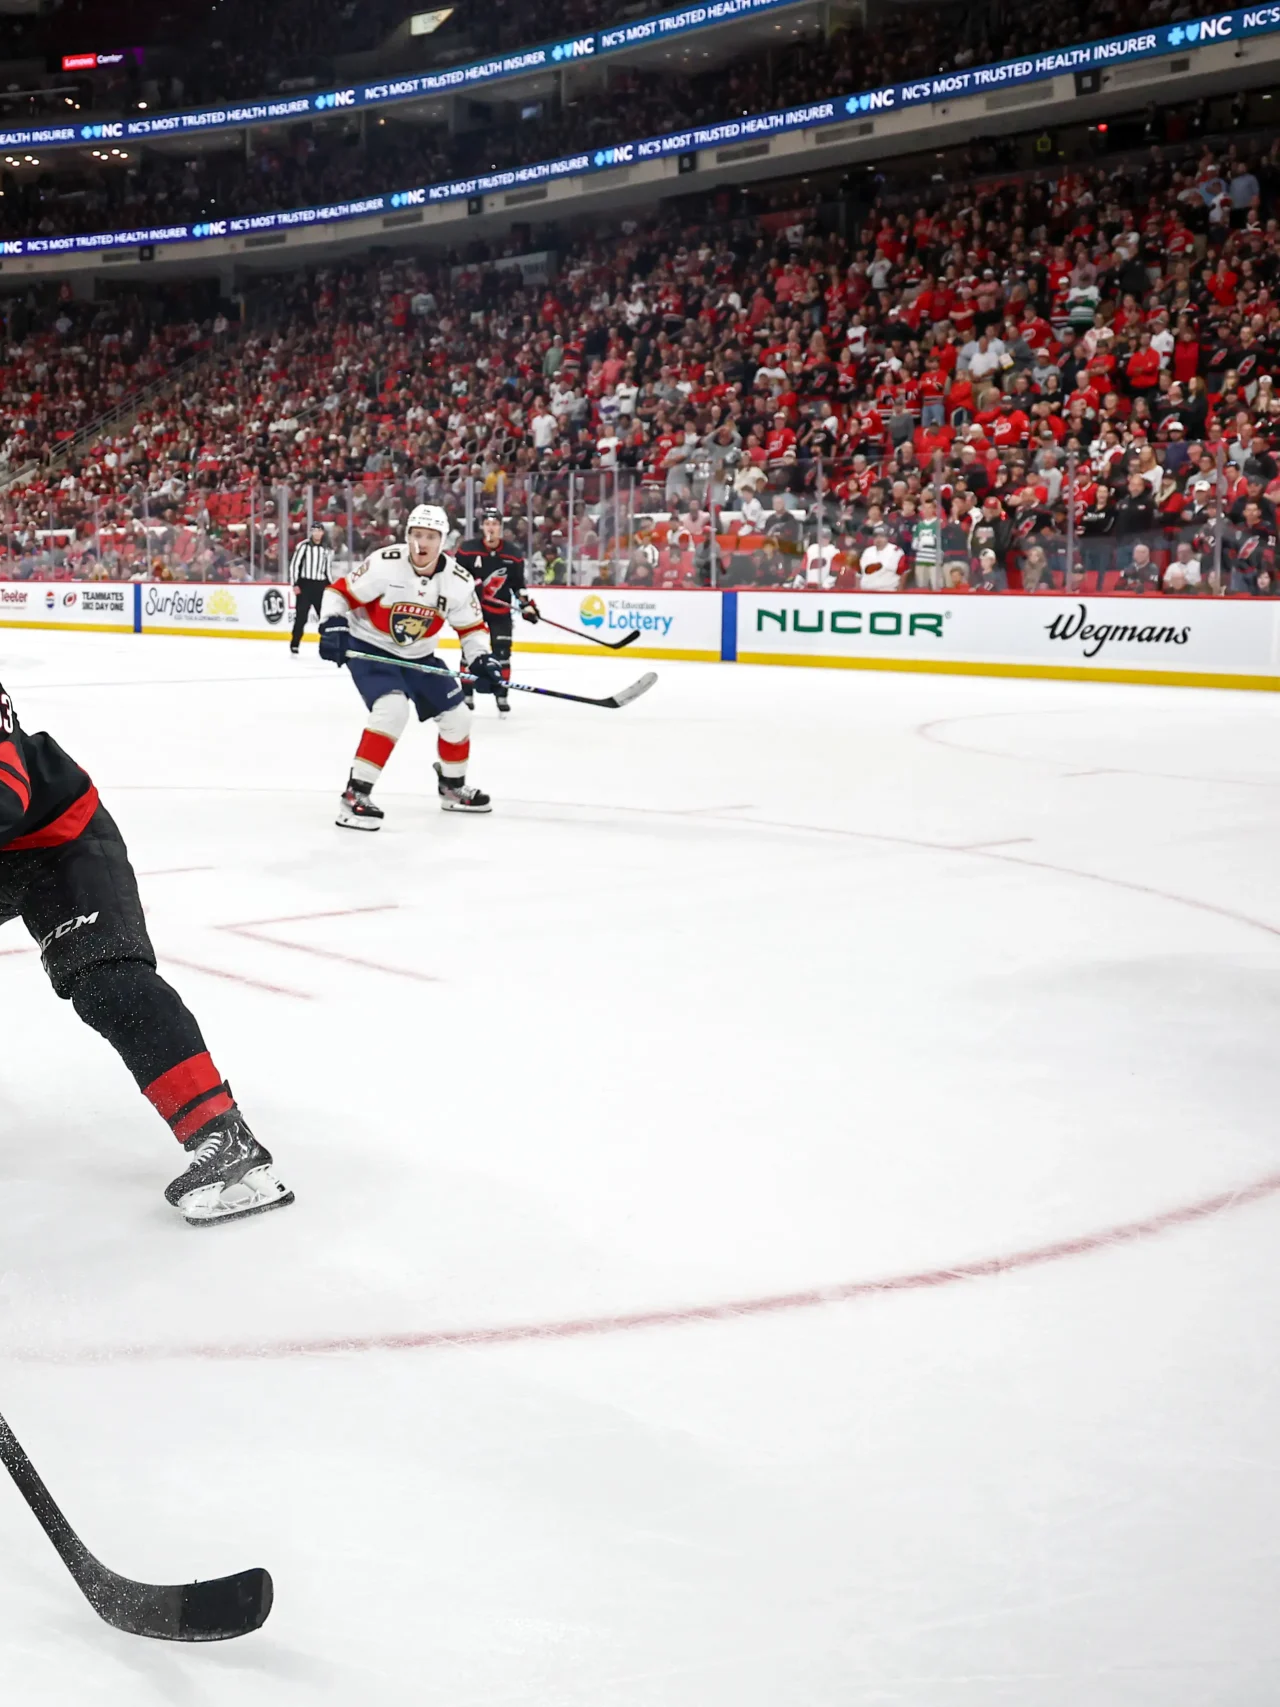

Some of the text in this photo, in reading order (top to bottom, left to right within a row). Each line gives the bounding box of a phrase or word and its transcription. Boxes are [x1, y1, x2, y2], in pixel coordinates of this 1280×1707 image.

[1243, 7, 1280, 27] NC'S
[601, 31, 626, 46] NC'S
[626, 22, 657, 39] MOST
[658, 9, 707, 31] TRUSTED
[1199, 16, 1233, 39] NC
[572, 38, 596, 56] NC
[364, 51, 546, 99] NC'S MOST TRUSTED HEALTH INSURER
[901, 35, 1157, 100] NC'S MOST TRUSTED HEALTH INSURER
[334, 90, 356, 107] NC
[869, 89, 895, 109] NC
[127, 100, 310, 133] NC'S MOST TRUSTED HEALTH INSURER
[31, 129, 75, 141] INSURER
[102, 123, 124, 137] NC
[638, 104, 834, 156] NC'S MOST TRUSTED HEALTH INSURER
[608, 145, 634, 162] NC
[429, 156, 589, 198] NC'S MOST TRUSTED HEALTH INSURER
[406, 190, 426, 204] NC
[230, 198, 384, 230] NC'S MOST TRUSTED HEALTH INSURER
[27, 227, 188, 250] NC'S MOST TRUSTED HEALTH INSURER
[208, 222, 227, 235] NC
[3, 241, 23, 253] NC
[0, 588, 28, 603] Teeter
[81, 591, 124, 601] TEAMMATES
[145, 587, 204, 616] Surfside
[436, 595, 448, 612] A
[95, 602, 109, 611] DAY
[110, 602, 124, 612] ONE
[265, 599, 284, 616] LBC
[608, 610, 674, 636] Lottery
[756, 609, 944, 637] NUCOR
[1045, 603, 1192, 658] Wegmans
[39, 911, 100, 952] CCM
